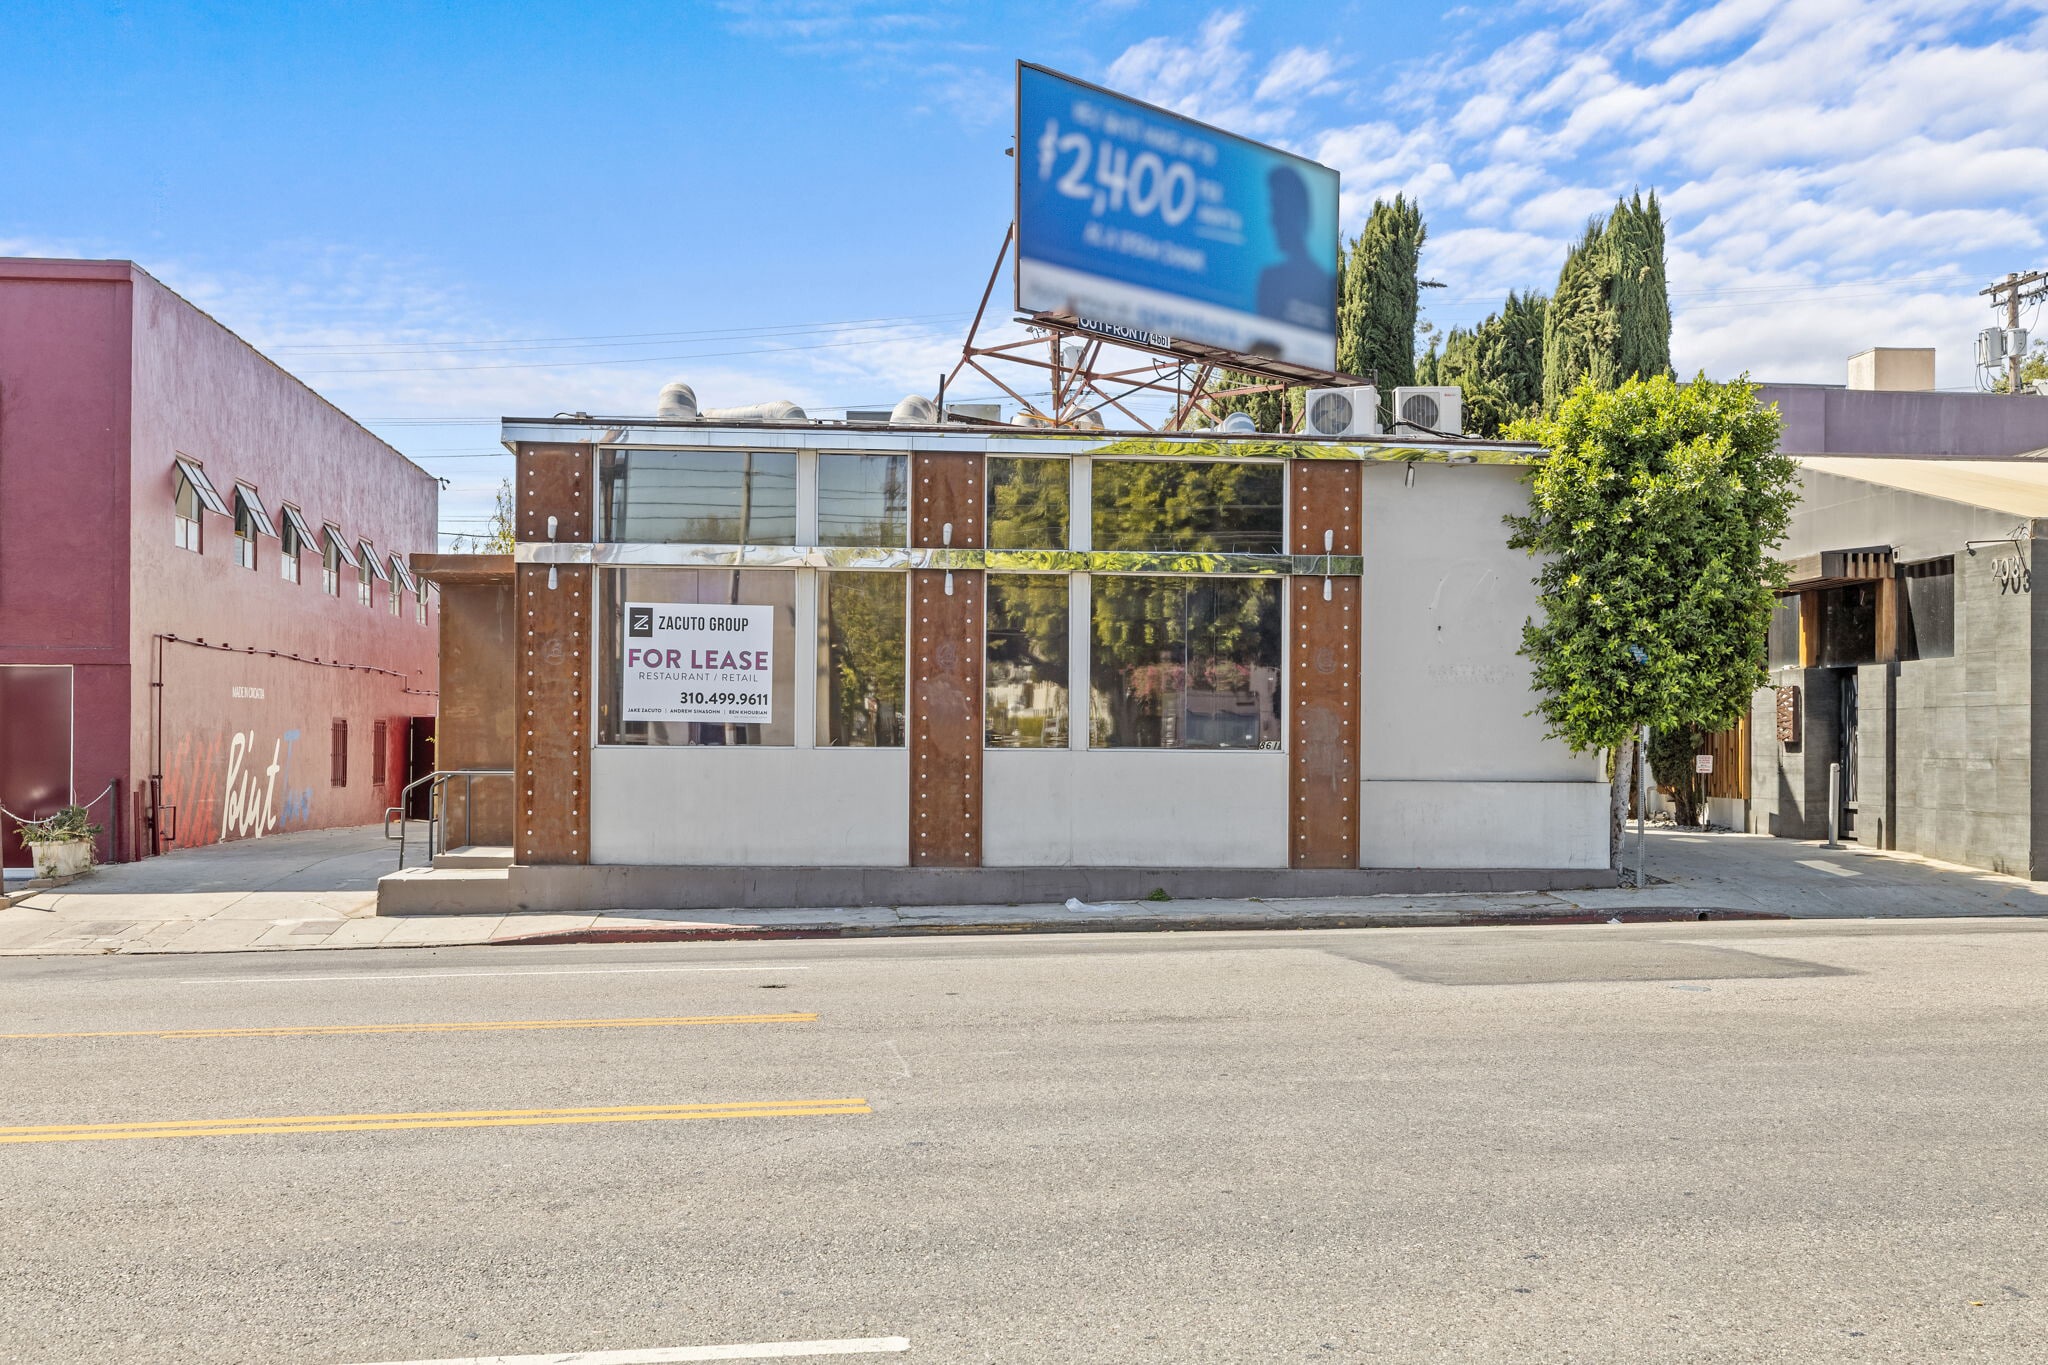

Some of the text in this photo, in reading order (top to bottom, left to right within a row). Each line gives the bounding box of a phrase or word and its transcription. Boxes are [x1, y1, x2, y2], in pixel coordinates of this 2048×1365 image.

[658, 615, 749, 632] ZACUTO GROUP
[628, 648, 769, 671] FOR LEASE
[638, 671, 710, 681] RESTAURANT
[721, 673, 759, 683] RETAIL
[680, 691, 768, 706] 310.499.9611
